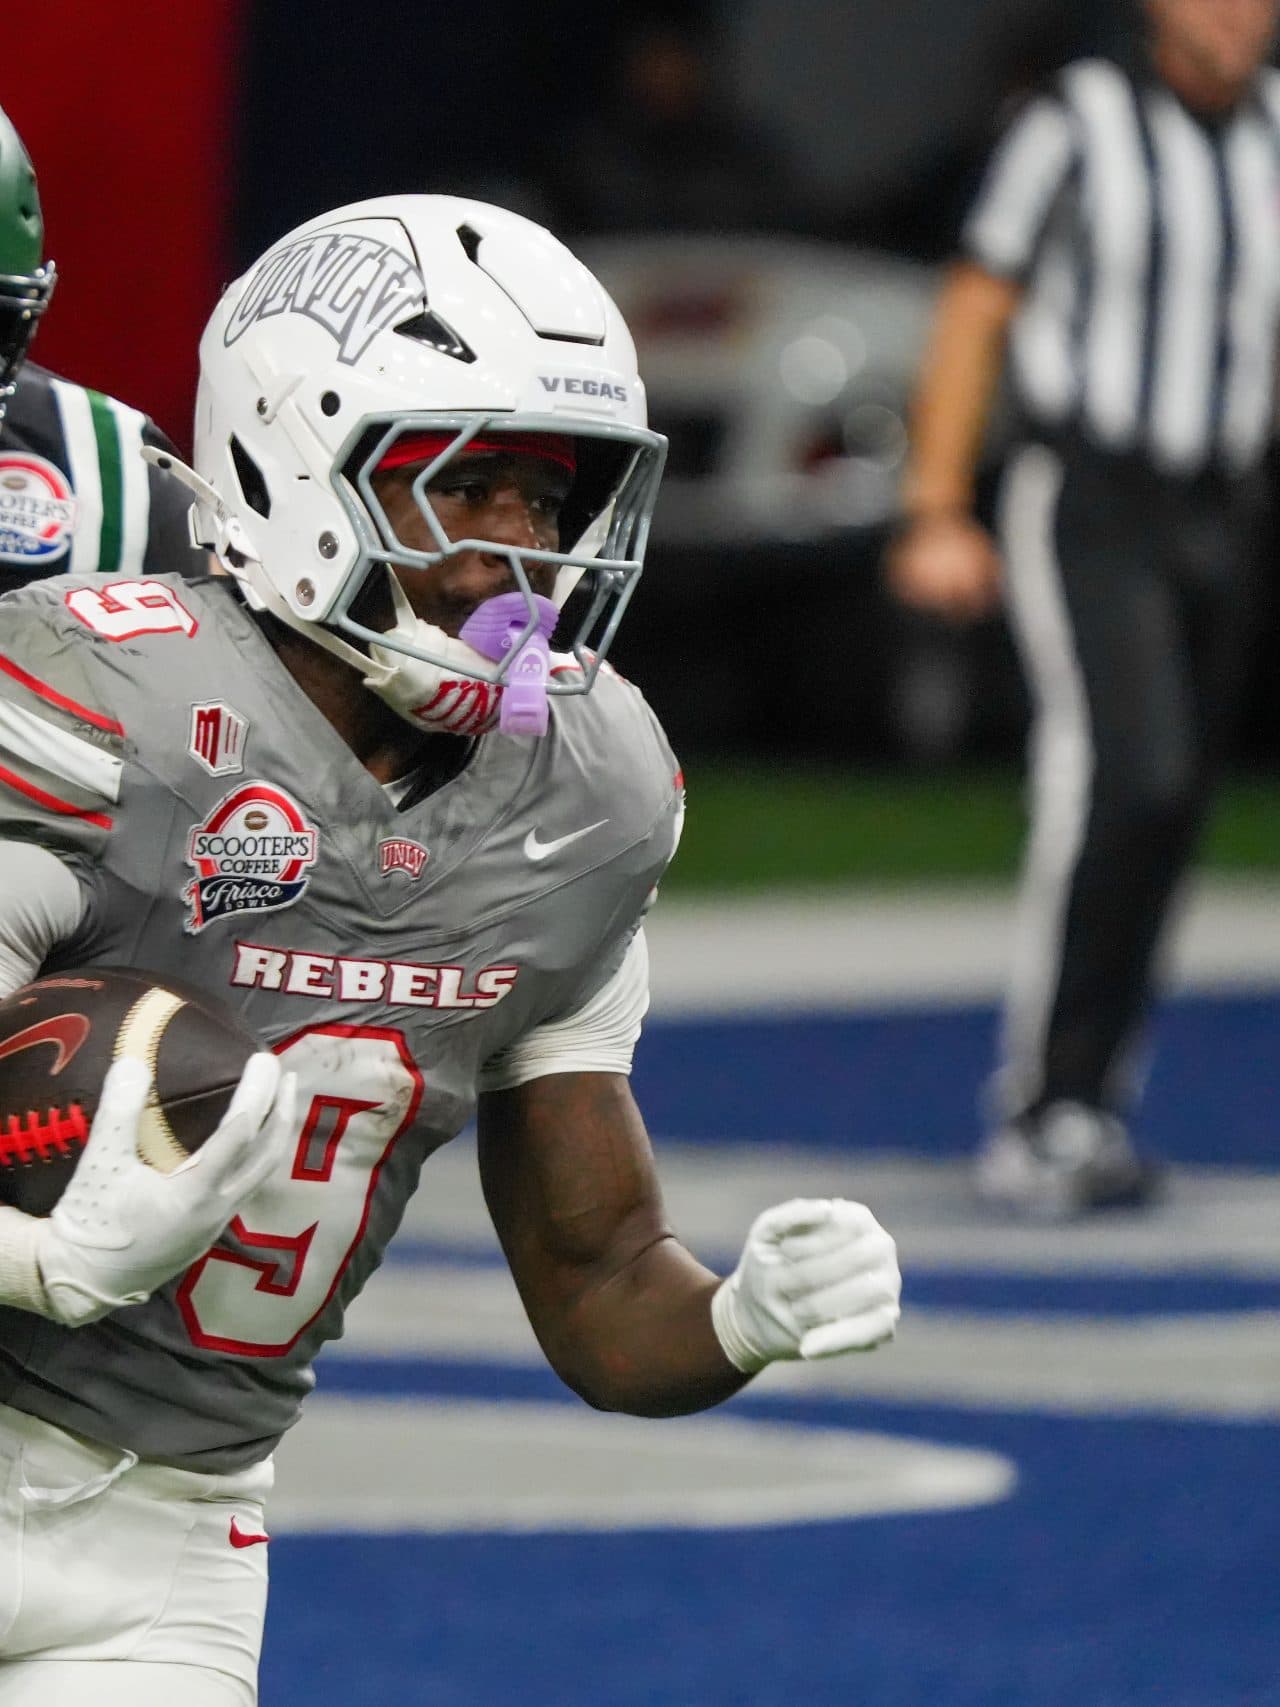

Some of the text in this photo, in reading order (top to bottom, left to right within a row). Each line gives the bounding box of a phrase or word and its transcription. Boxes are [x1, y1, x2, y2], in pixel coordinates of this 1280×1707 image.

[224, 234, 427, 367] UNLV
[538, 376, 627, 402] VEGAS
[64, 580, 199, 643] 9
[195, 836, 310, 857] SCOOTER'S
[382, 842, 426, 875] UNLV
[220, 859, 281, 874] COFFEE
[201, 877, 283, 912] Frisco
[229, 940, 520, 1010] REBELS
[176, 1023, 426, 1358] 9
